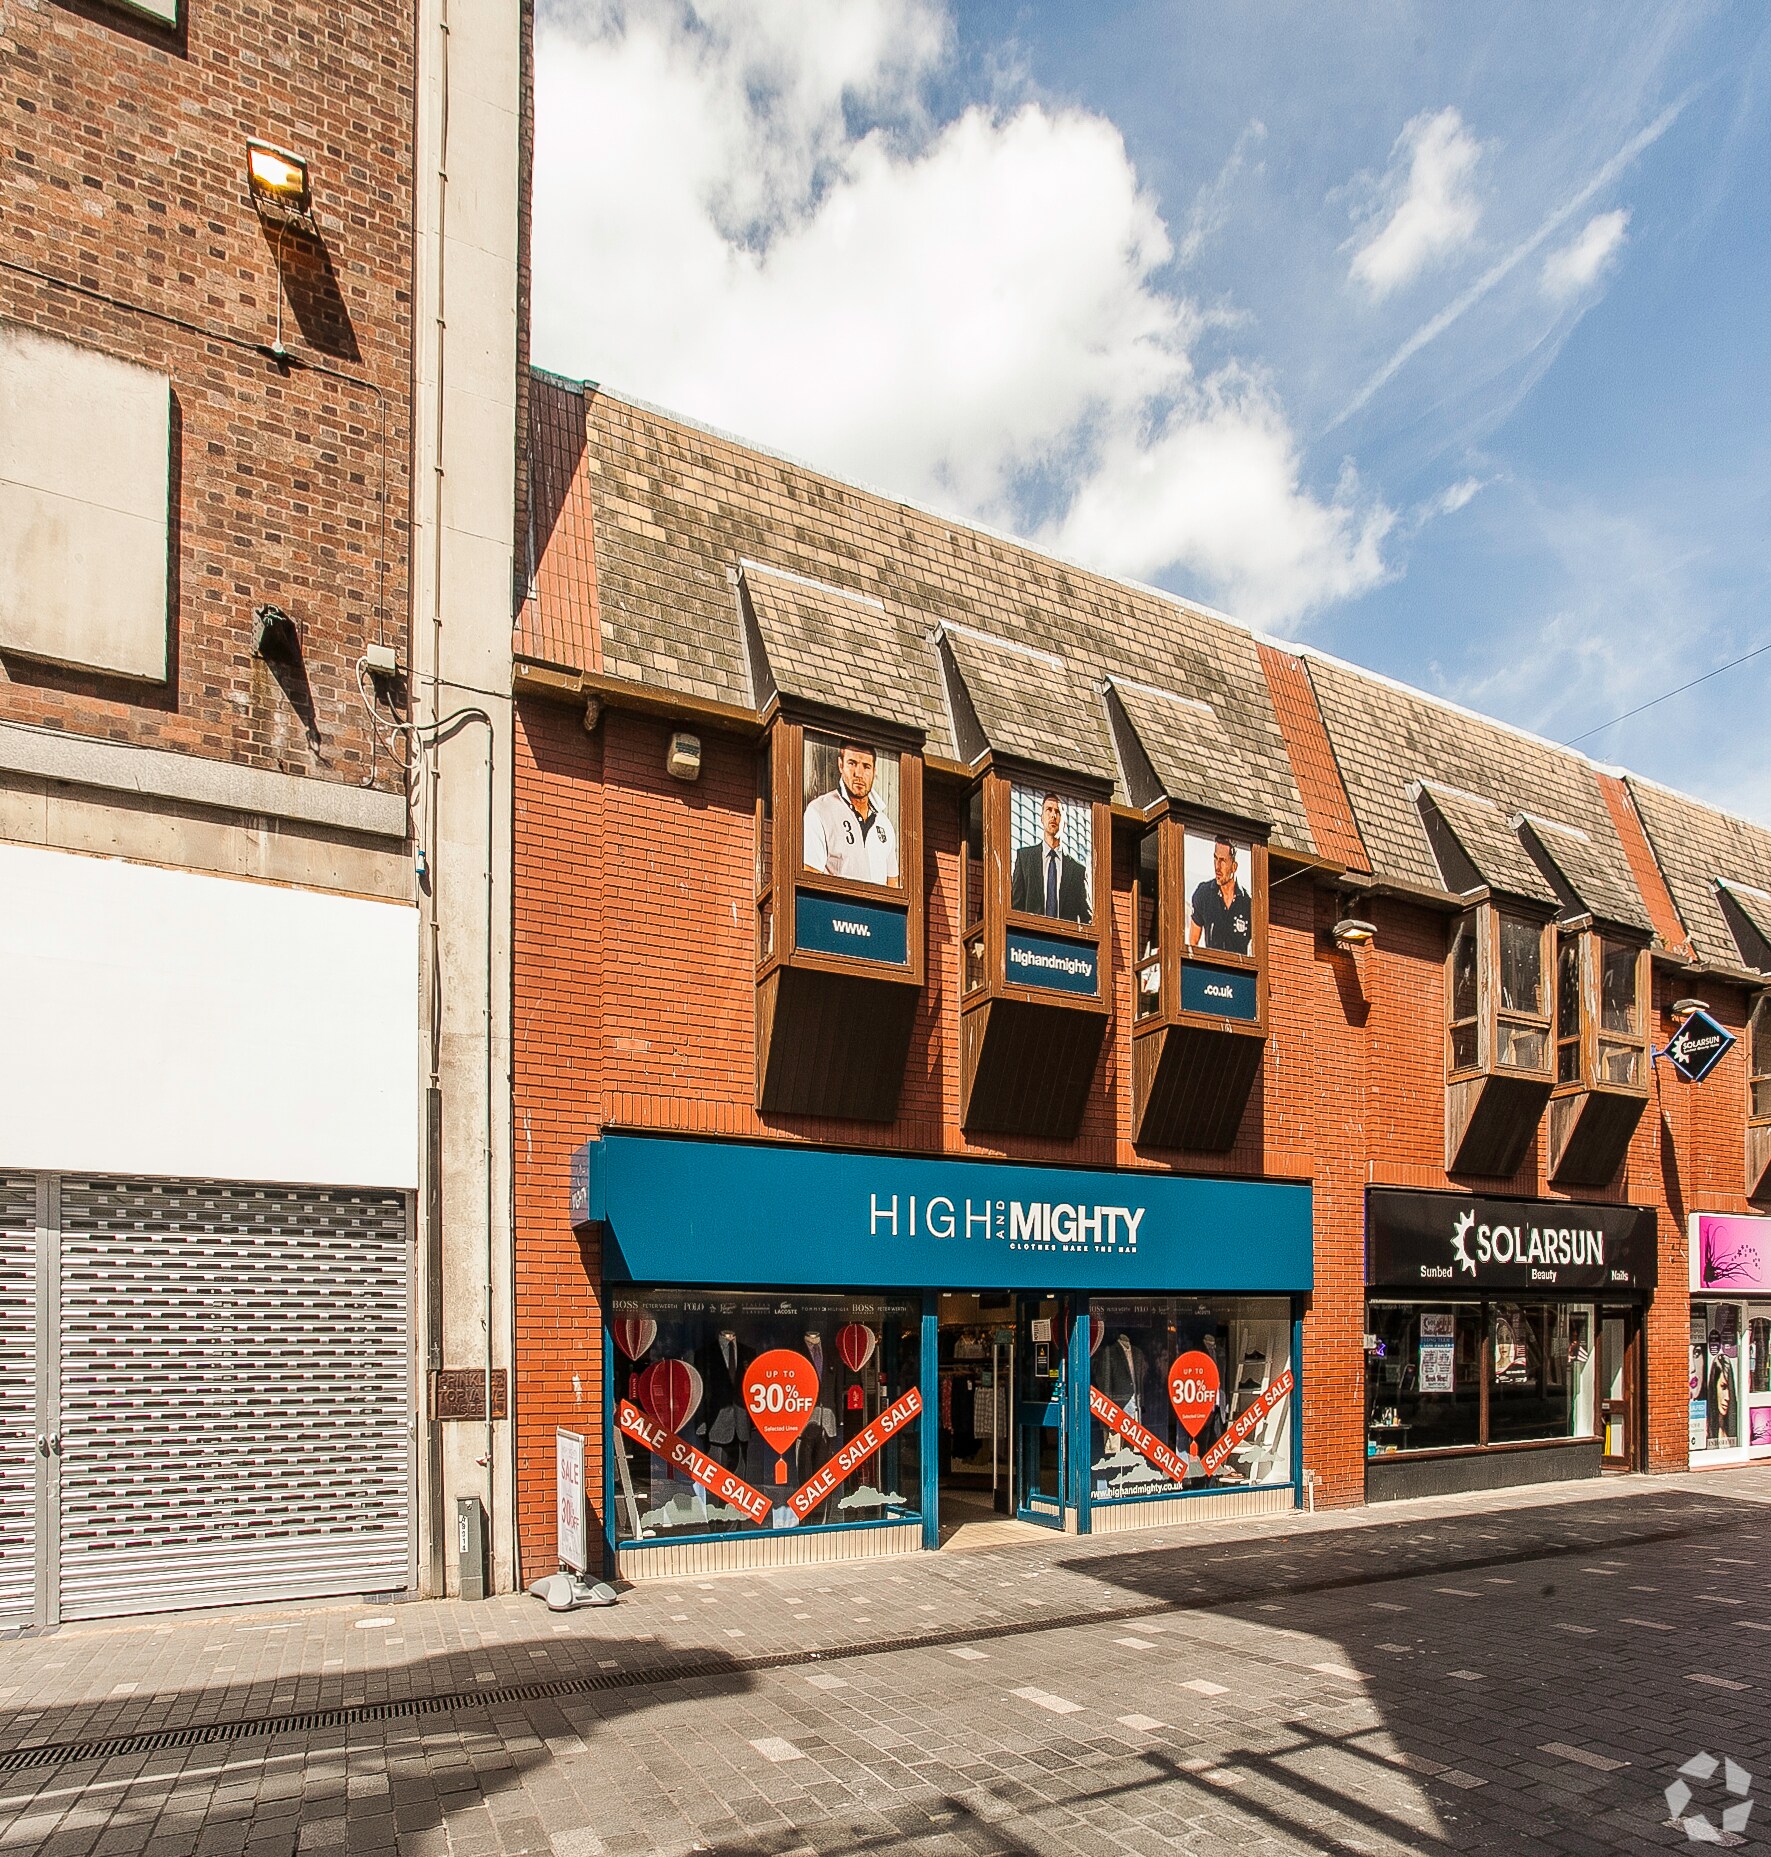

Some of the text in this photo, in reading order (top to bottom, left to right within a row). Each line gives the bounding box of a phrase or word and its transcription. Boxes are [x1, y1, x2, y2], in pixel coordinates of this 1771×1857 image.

[842, 820, 855, 845] 3
[832, 919, 871, 937] www.
[1010, 947, 1093, 977] highandmighty
[1203, 984, 1234, 999] .co.uk
[1682, 1035, 1720, 1050] SOLARSUN
[870, 1193, 1146, 1244] HIGH AND MIGHTY
[1009, 1242, 1057, 1252] CLOTHES
[1062, 1243, 1090, 1252] MAKE
[1094, 1245, 1113, 1253] THE
[1476, 1224, 1604, 1266] SOLARSUN
[1420, 1265, 1629, 1283] Sunbed Beauty Nails
[612, 1300, 639, 1309] BOSS
[852, 1303, 874, 1312] BOSS
[766, 1370, 795, 1378] UP TO
[784, 1397, 813, 1413] OFF
[1195, 1390, 1216, 1403] OFF
[450, 1403, 484, 1414] INSIDE
[1205, 1374, 1292, 1469] SALE SALE SALE
[1090, 1391, 1184, 1478] SALE SALE SALE
[795, 1393, 921, 1512] SALE SALE SALE
[620, 1408, 767, 1517] SALE SALE SALE
[561, 1458, 579, 1486] SALE
